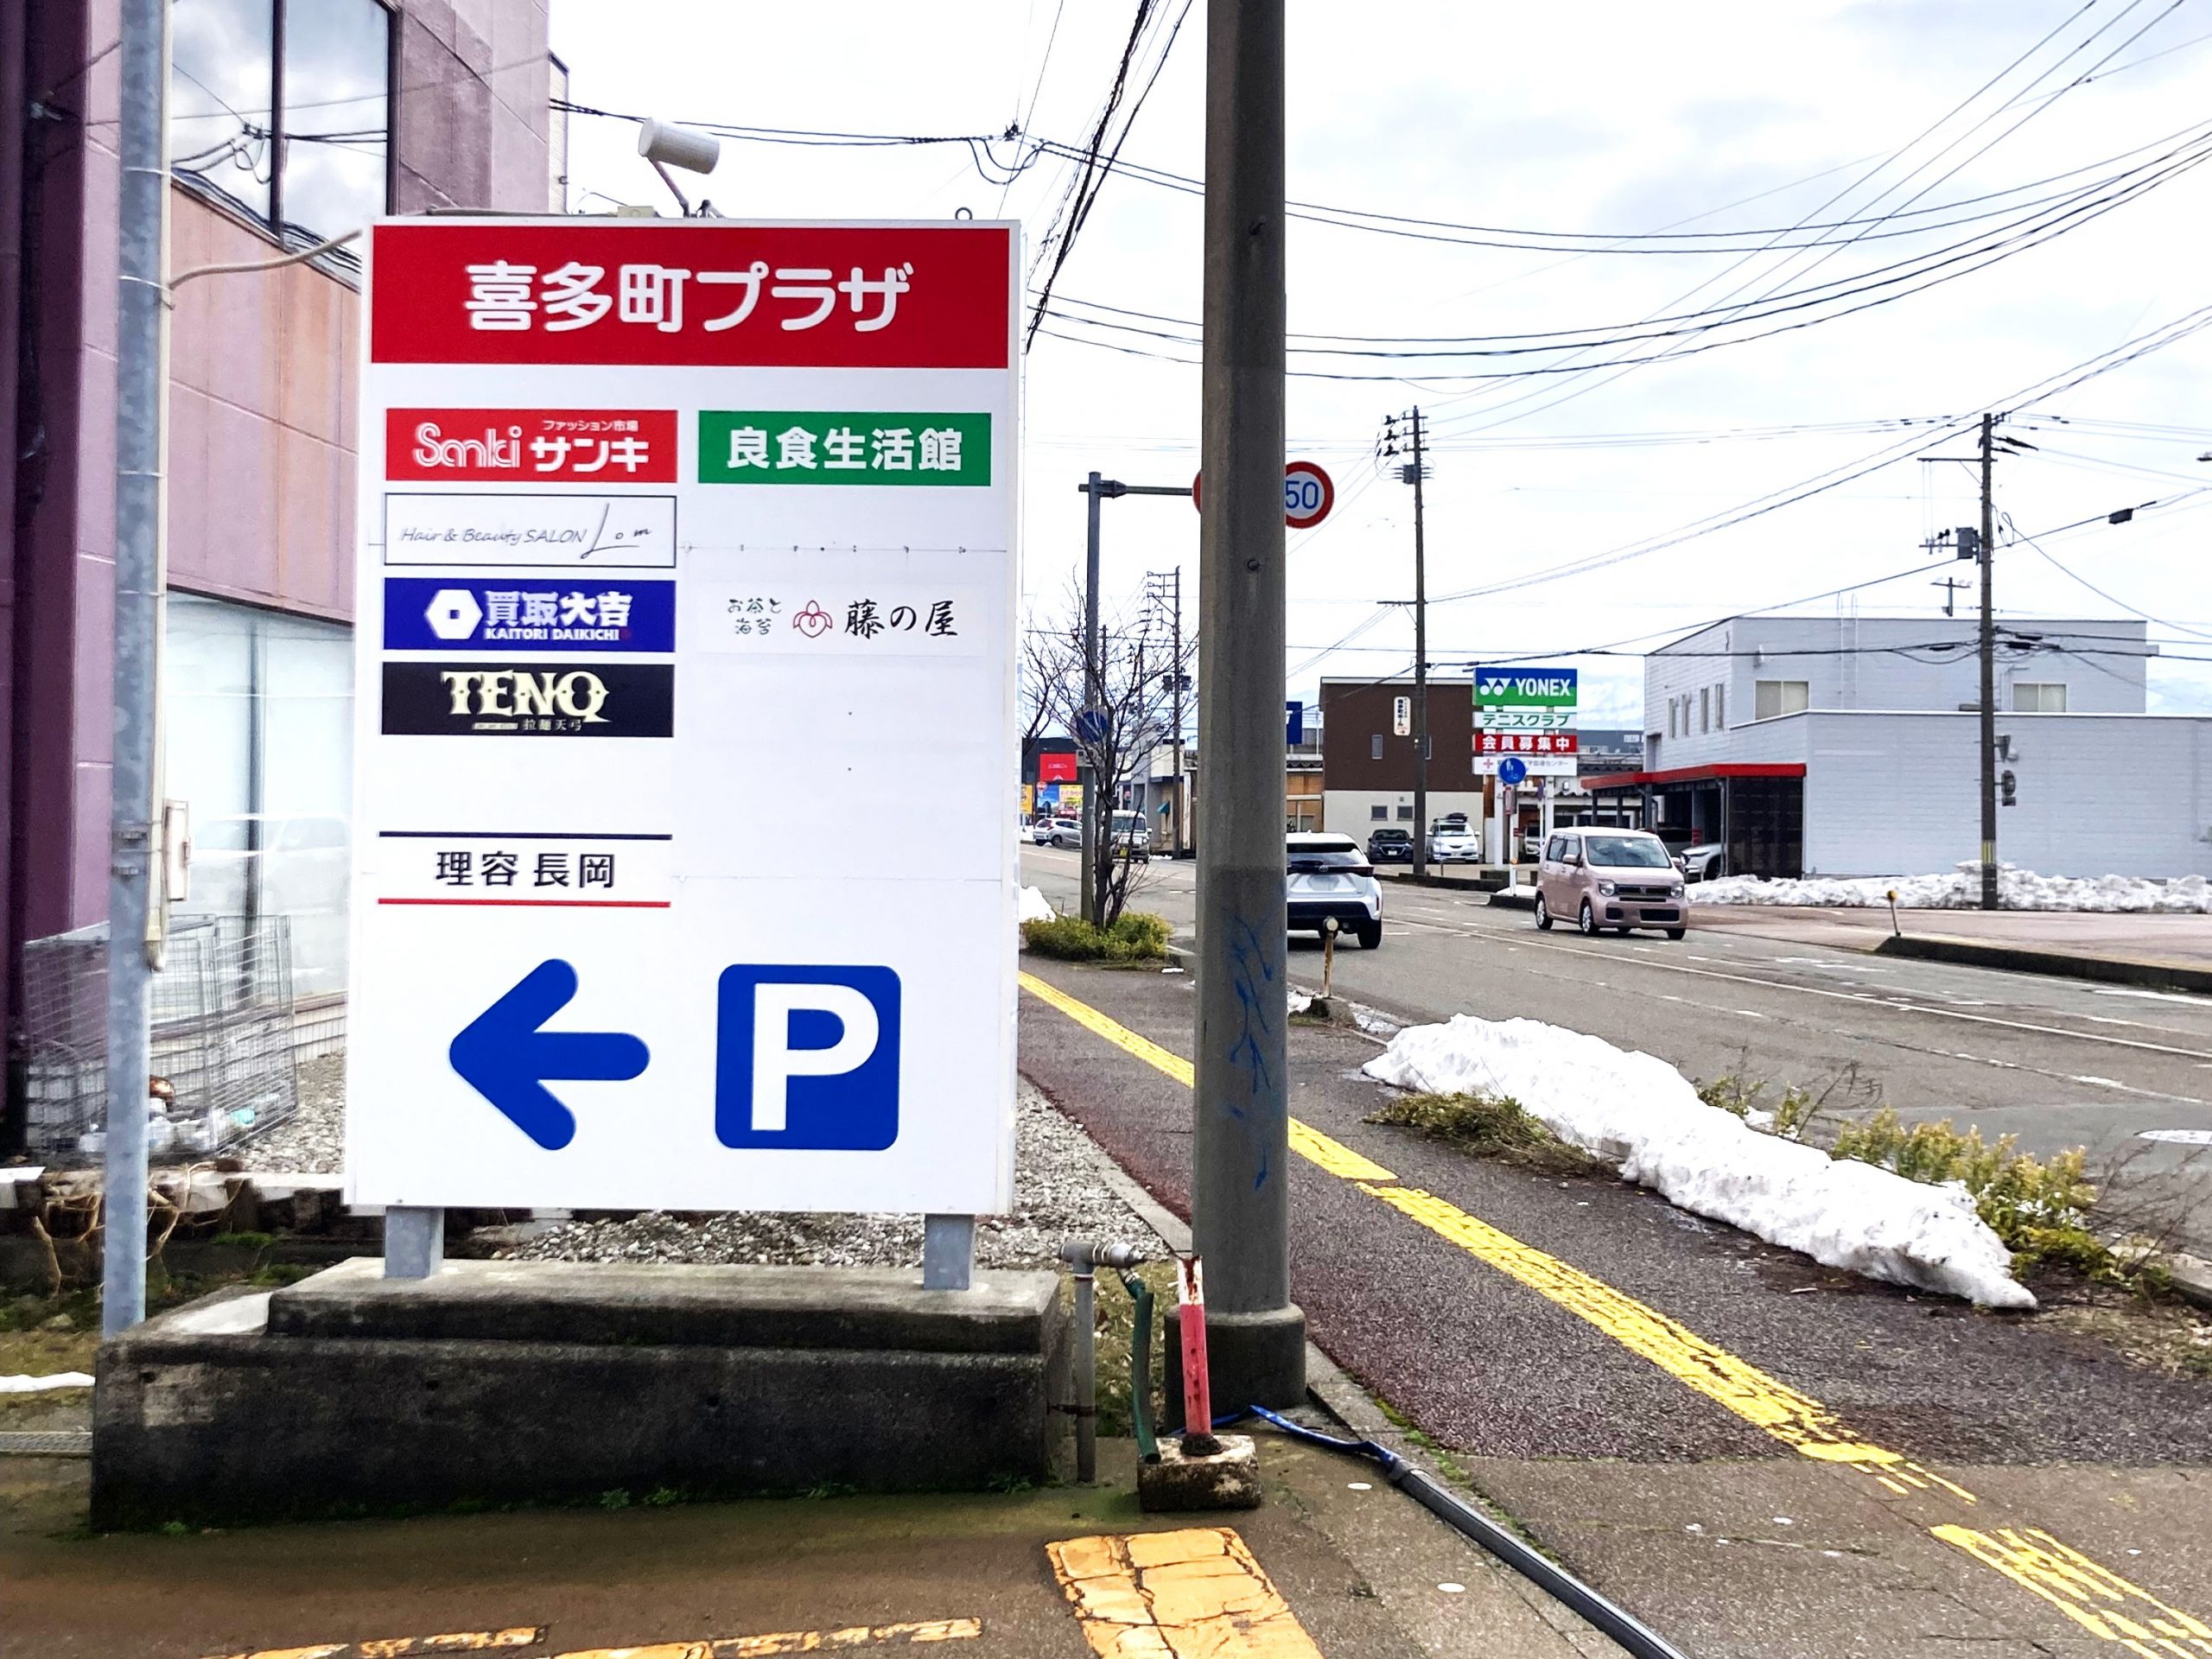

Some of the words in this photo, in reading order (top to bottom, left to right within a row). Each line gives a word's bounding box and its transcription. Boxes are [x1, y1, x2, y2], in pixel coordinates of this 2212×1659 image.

[463, 259, 914, 334] 喜多町プラザ
[542, 419, 639, 432] ファッション市場
[414, 422, 523, 468] Sanki
[529, 435, 649, 473] サンキ
[727, 426, 963, 472] 良食生活館
[1285, 480, 1319, 510] 50
[401, 527, 439, 543] Hair
[442, 528, 460, 543] &
[461, 528, 522, 546] Beauty
[523, 528, 588, 543] SALON
[484, 589, 633, 627] 買取大吉
[727, 597, 783, 614] お茶と
[844, 598, 959, 639] 藤の屋
[484, 627, 549, 640] KAITORI
[551, 627, 620, 641] DAIKICHI
[734, 617, 772, 635] 海苔
[441, 669, 612, 722] TENQ
[1515, 677, 1572, 697] YONEX
[1482, 714, 1570, 727] テニスクラブ
[1482, 734, 1570, 752] 会員募集中
[435, 849, 616, 889] 理容長岡
[751, 982, 880, 1132] P
